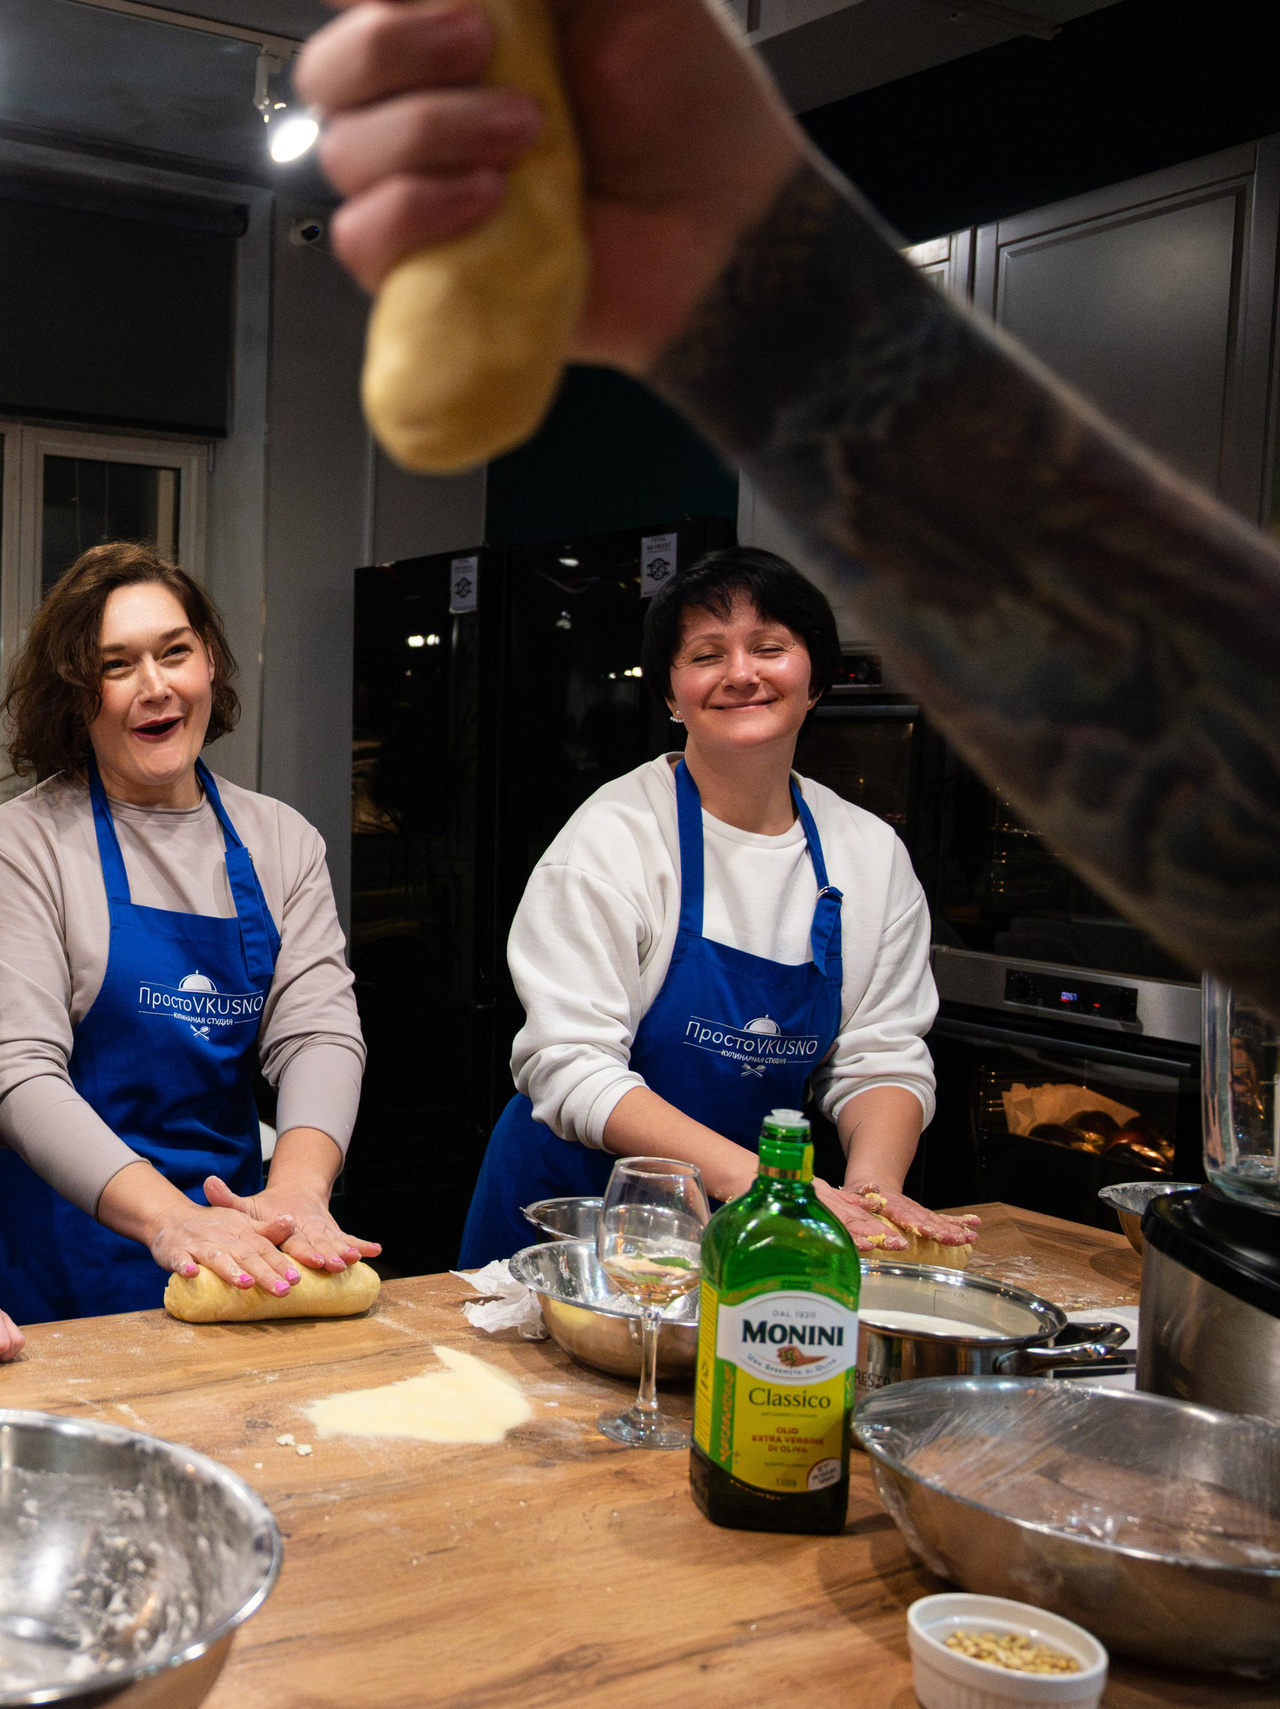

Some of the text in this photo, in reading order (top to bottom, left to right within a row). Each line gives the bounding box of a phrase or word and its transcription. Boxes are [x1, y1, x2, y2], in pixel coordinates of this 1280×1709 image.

[138, 986, 264, 1015] ПростоVKUSNO
[206, 1017, 234, 1026] СТУДИЯ
[685, 1020, 818, 1056] ПростоVKUSNO
[772, 1309, 817, 1319] DAL 1920
[742, 1319, 844, 1347] MONINI
[748, 1386, 831, 1409] Classico
[775, 1426, 799, 1435] OLIO
[751, 1434, 782, 1443] EXTRA
[767, 1445, 778, 1453] DI
